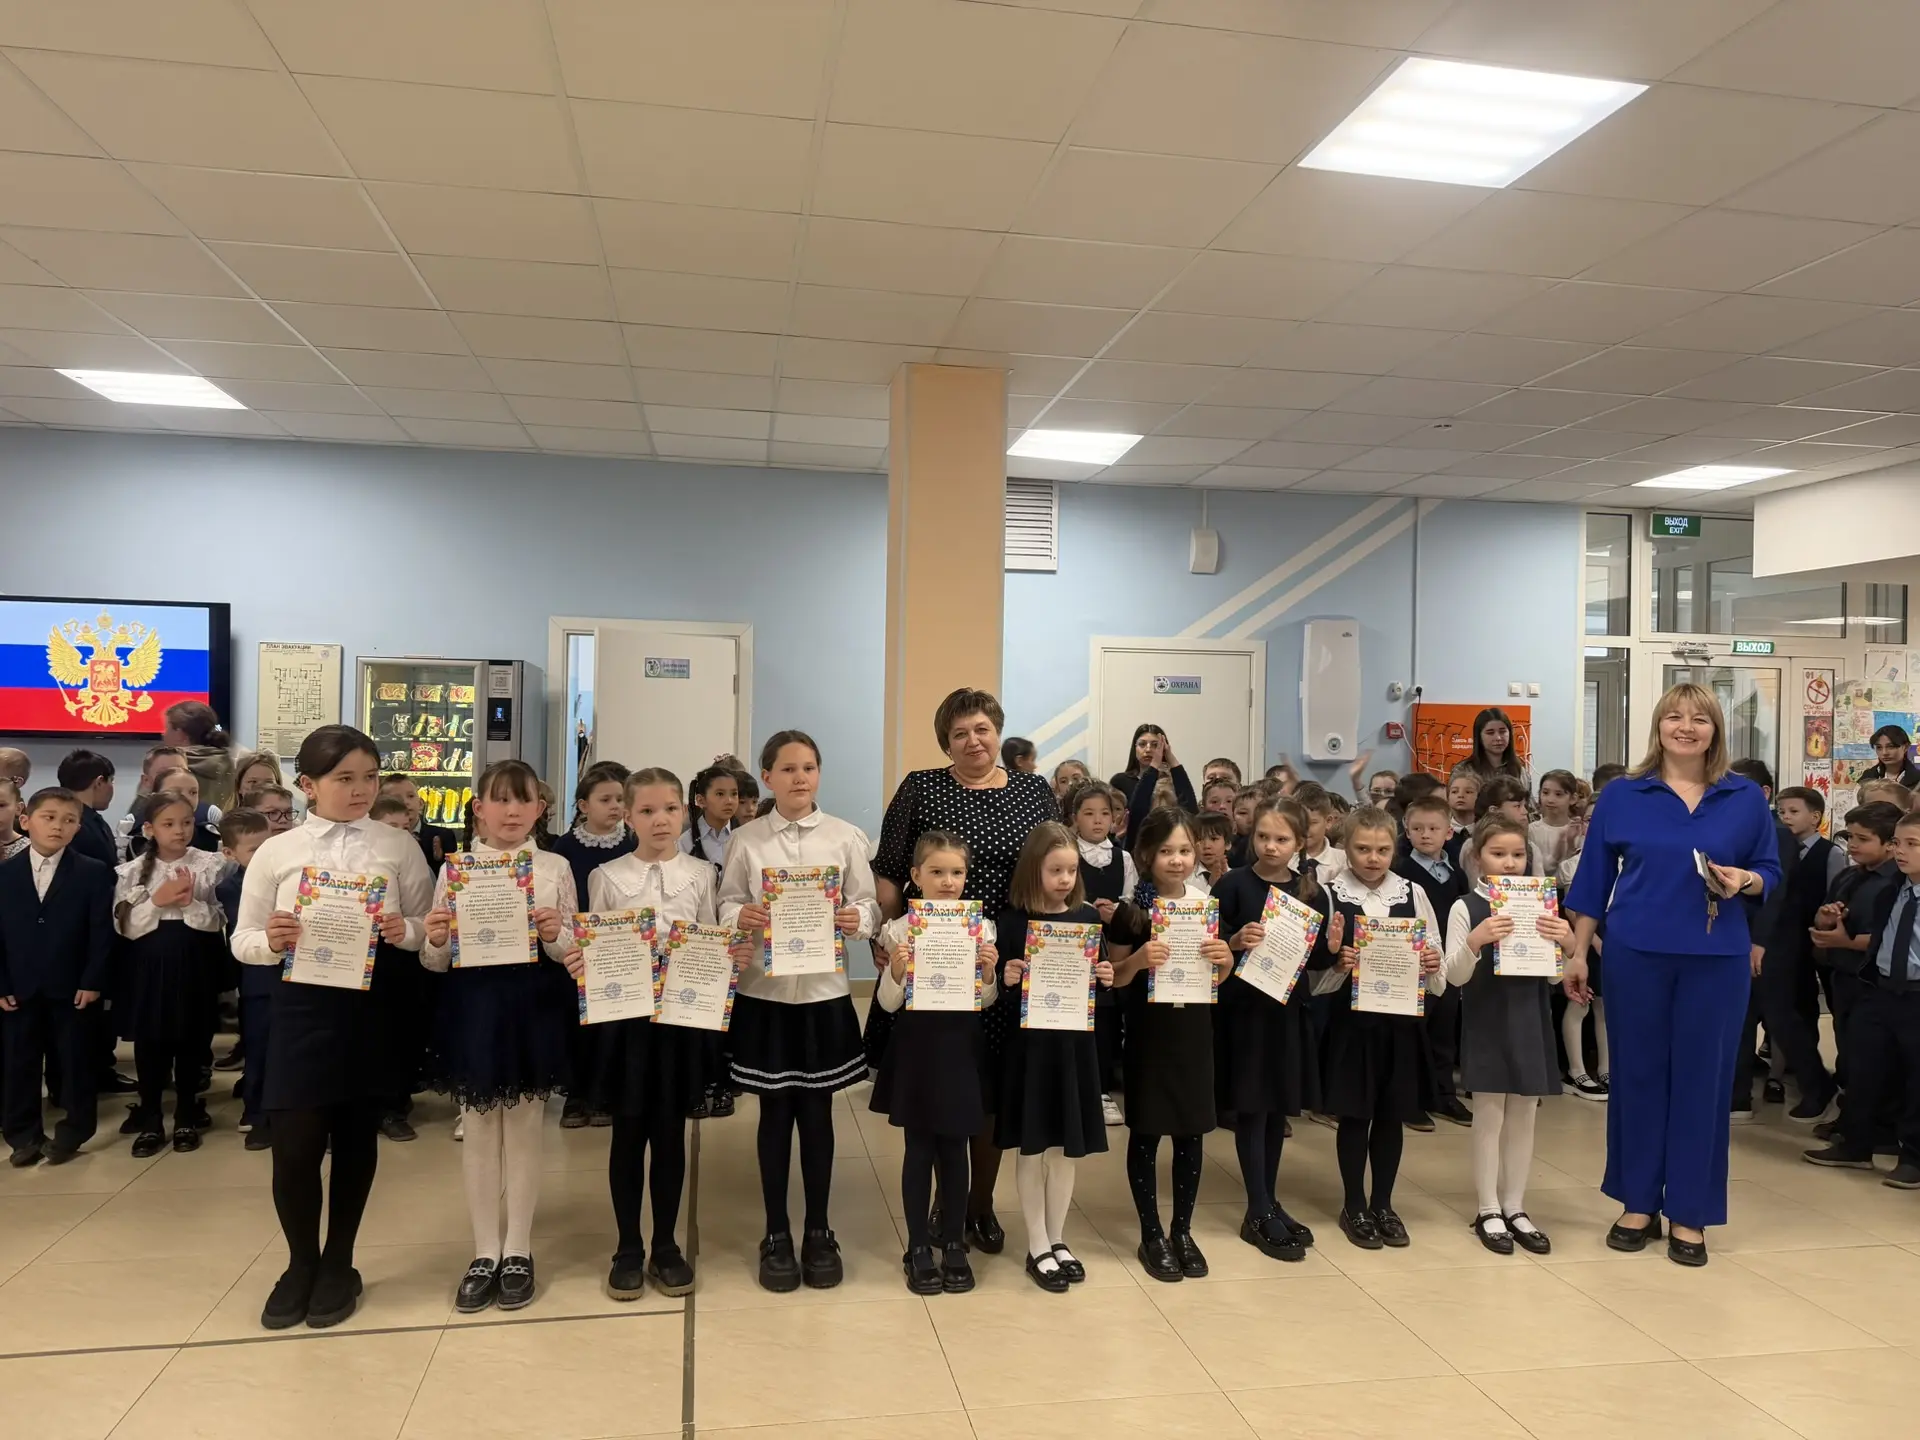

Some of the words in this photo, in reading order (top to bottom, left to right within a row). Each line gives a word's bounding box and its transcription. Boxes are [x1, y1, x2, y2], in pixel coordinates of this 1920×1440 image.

[1664, 517, 1688, 527] ВЫХОД
[1736, 642, 1772, 653] ВЫХОД
[1170, 681, 1199, 689] ОХРАНА
